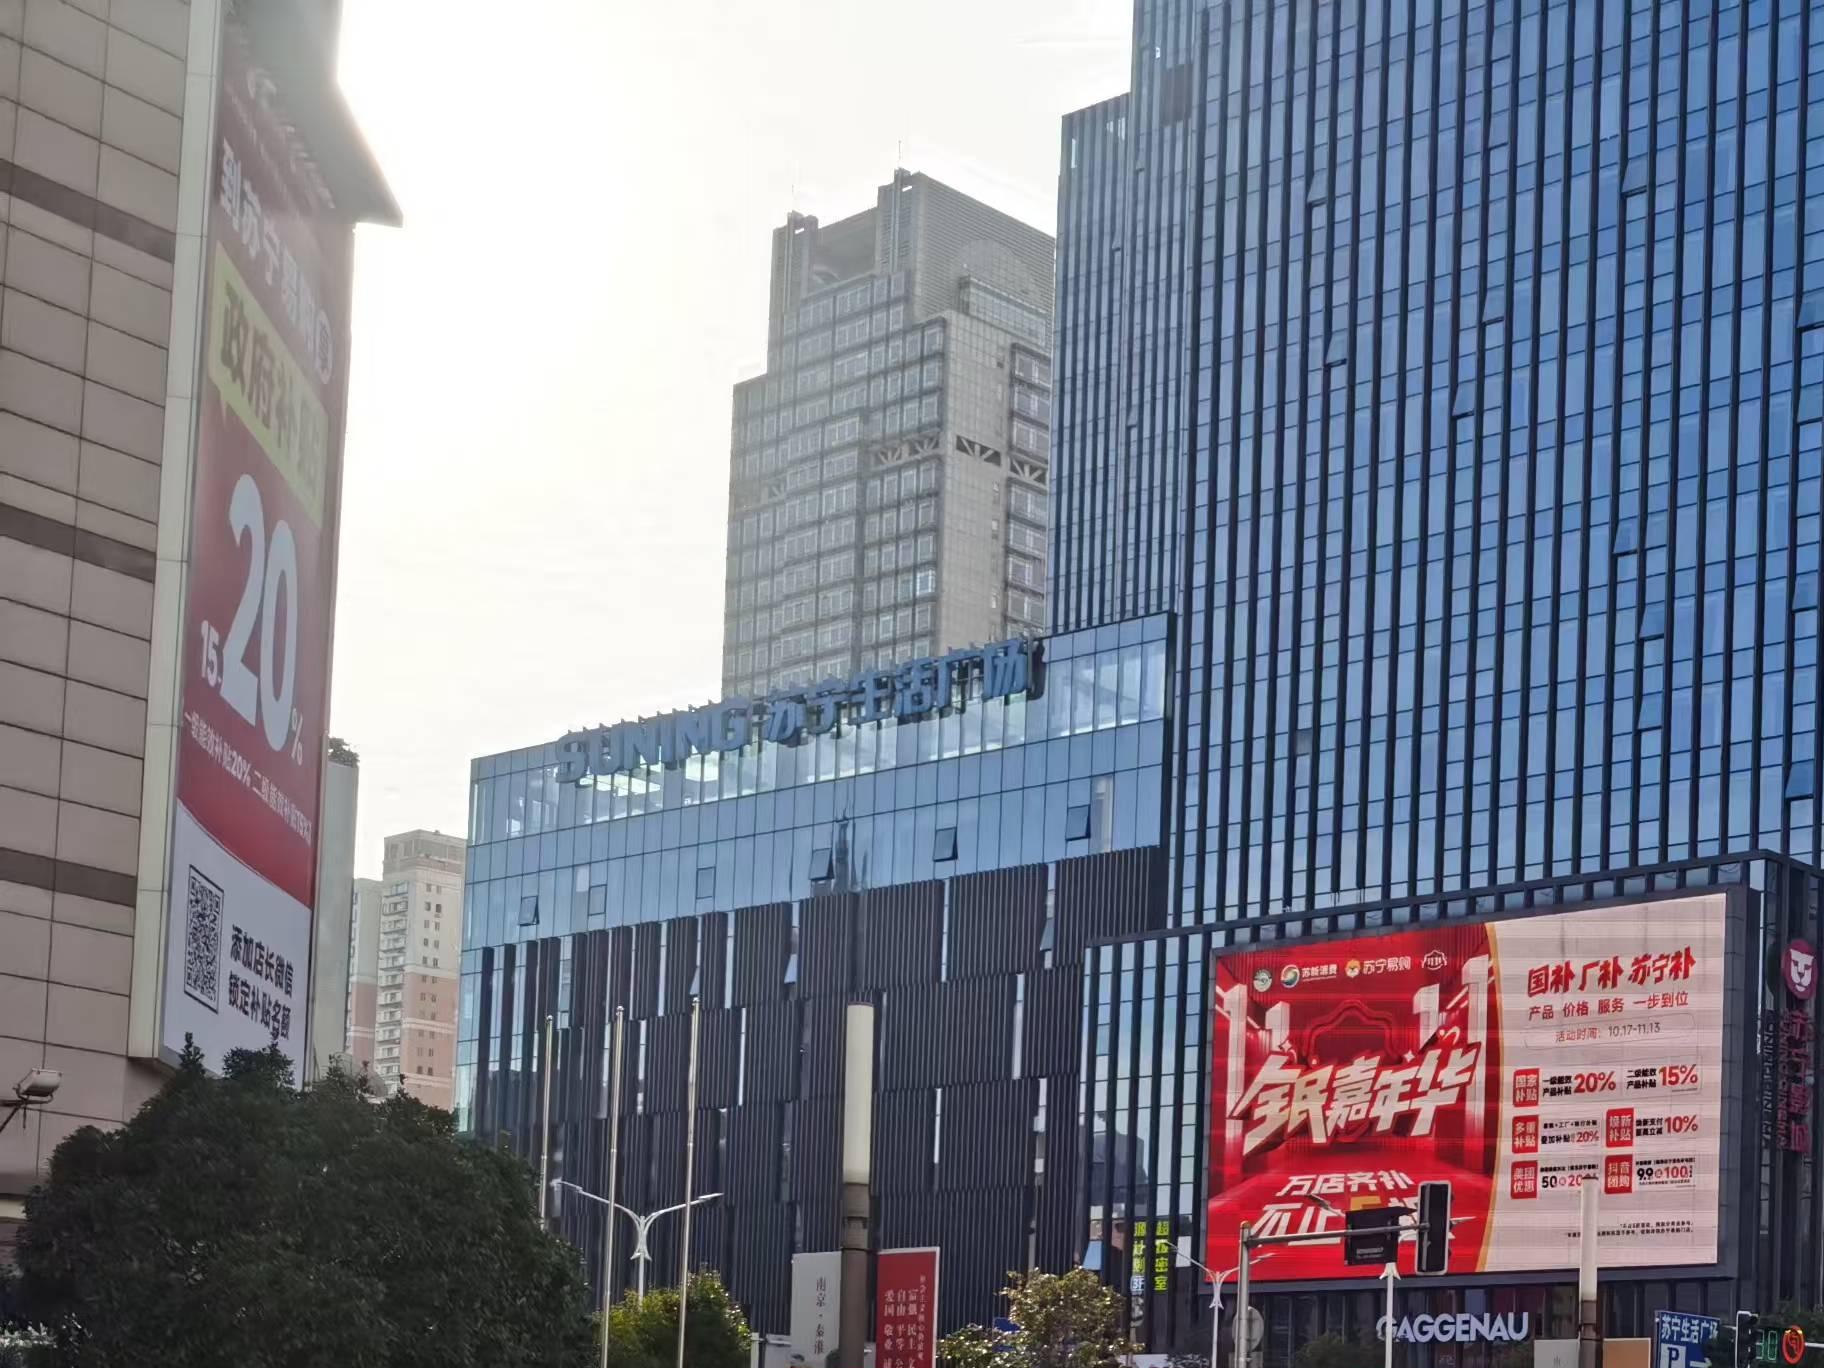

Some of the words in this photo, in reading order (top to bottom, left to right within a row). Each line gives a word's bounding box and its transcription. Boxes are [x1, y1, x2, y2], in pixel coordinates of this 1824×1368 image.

[555, 700, 749, 784] SUNING
[1363, 956, 1412, 975] 苏宁易购
[1528, 960, 1576, 998] 国补
[1578, 956, 1624, 992] 厂补
[1627, 946, 1697, 986] 苏宁补
[1528, 1005, 1555, 1021] 产品
[1562, 1001, 1589, 1018] 价格
[1598, 998, 1624, 1015] 服务
[1633, 991, 1689, 1010] 一步到位
[1608, 1022, 1661, 1037] 10.17-11.13
[1573, 1071, 1617, 1094] 20%
[1658, 1064, 1698, 1087] 15%
[1234, 1047, 1479, 1156] 全民嘉年华
[1515, 1088, 1537, 1103] 补贴
[1664, 1115, 1698, 1134] 10%
[1275, 1169, 1415, 1197] 万店齐补
[1513, 1180, 1536, 1193] 优惠
[1375, 1311, 1530, 1344] GAGGENAU
[1661, 1314, 1719, 1343] 苏宁生活广场
